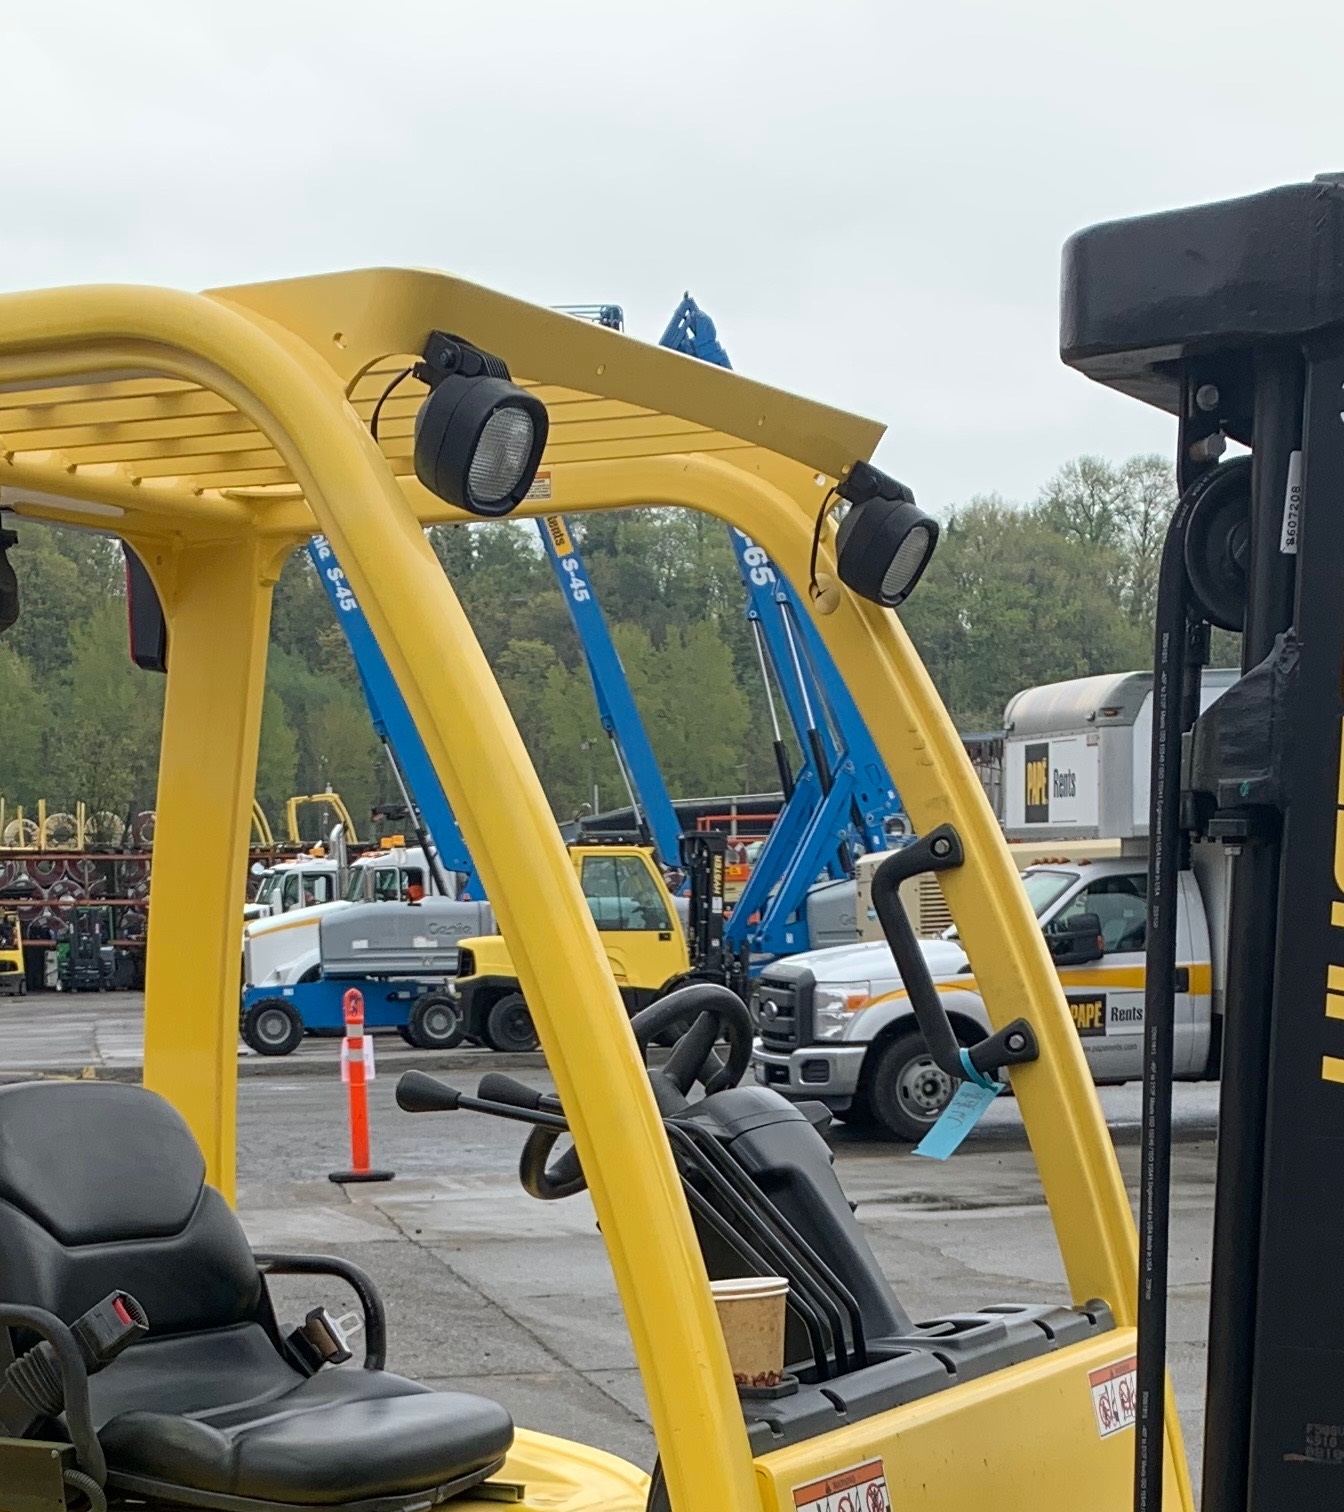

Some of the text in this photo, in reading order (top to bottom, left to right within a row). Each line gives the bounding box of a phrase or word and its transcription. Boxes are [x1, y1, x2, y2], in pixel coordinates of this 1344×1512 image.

[1286, 485, 1301, 546] 8607208
[326, 566, 357, 612] S-45
[562, 558, 590, 602] S-45
[1053, 768, 1076, 798] Rents
[713, 855, 723, 895] HYSTER
[1111, 1006, 1143, 1022] Rents
